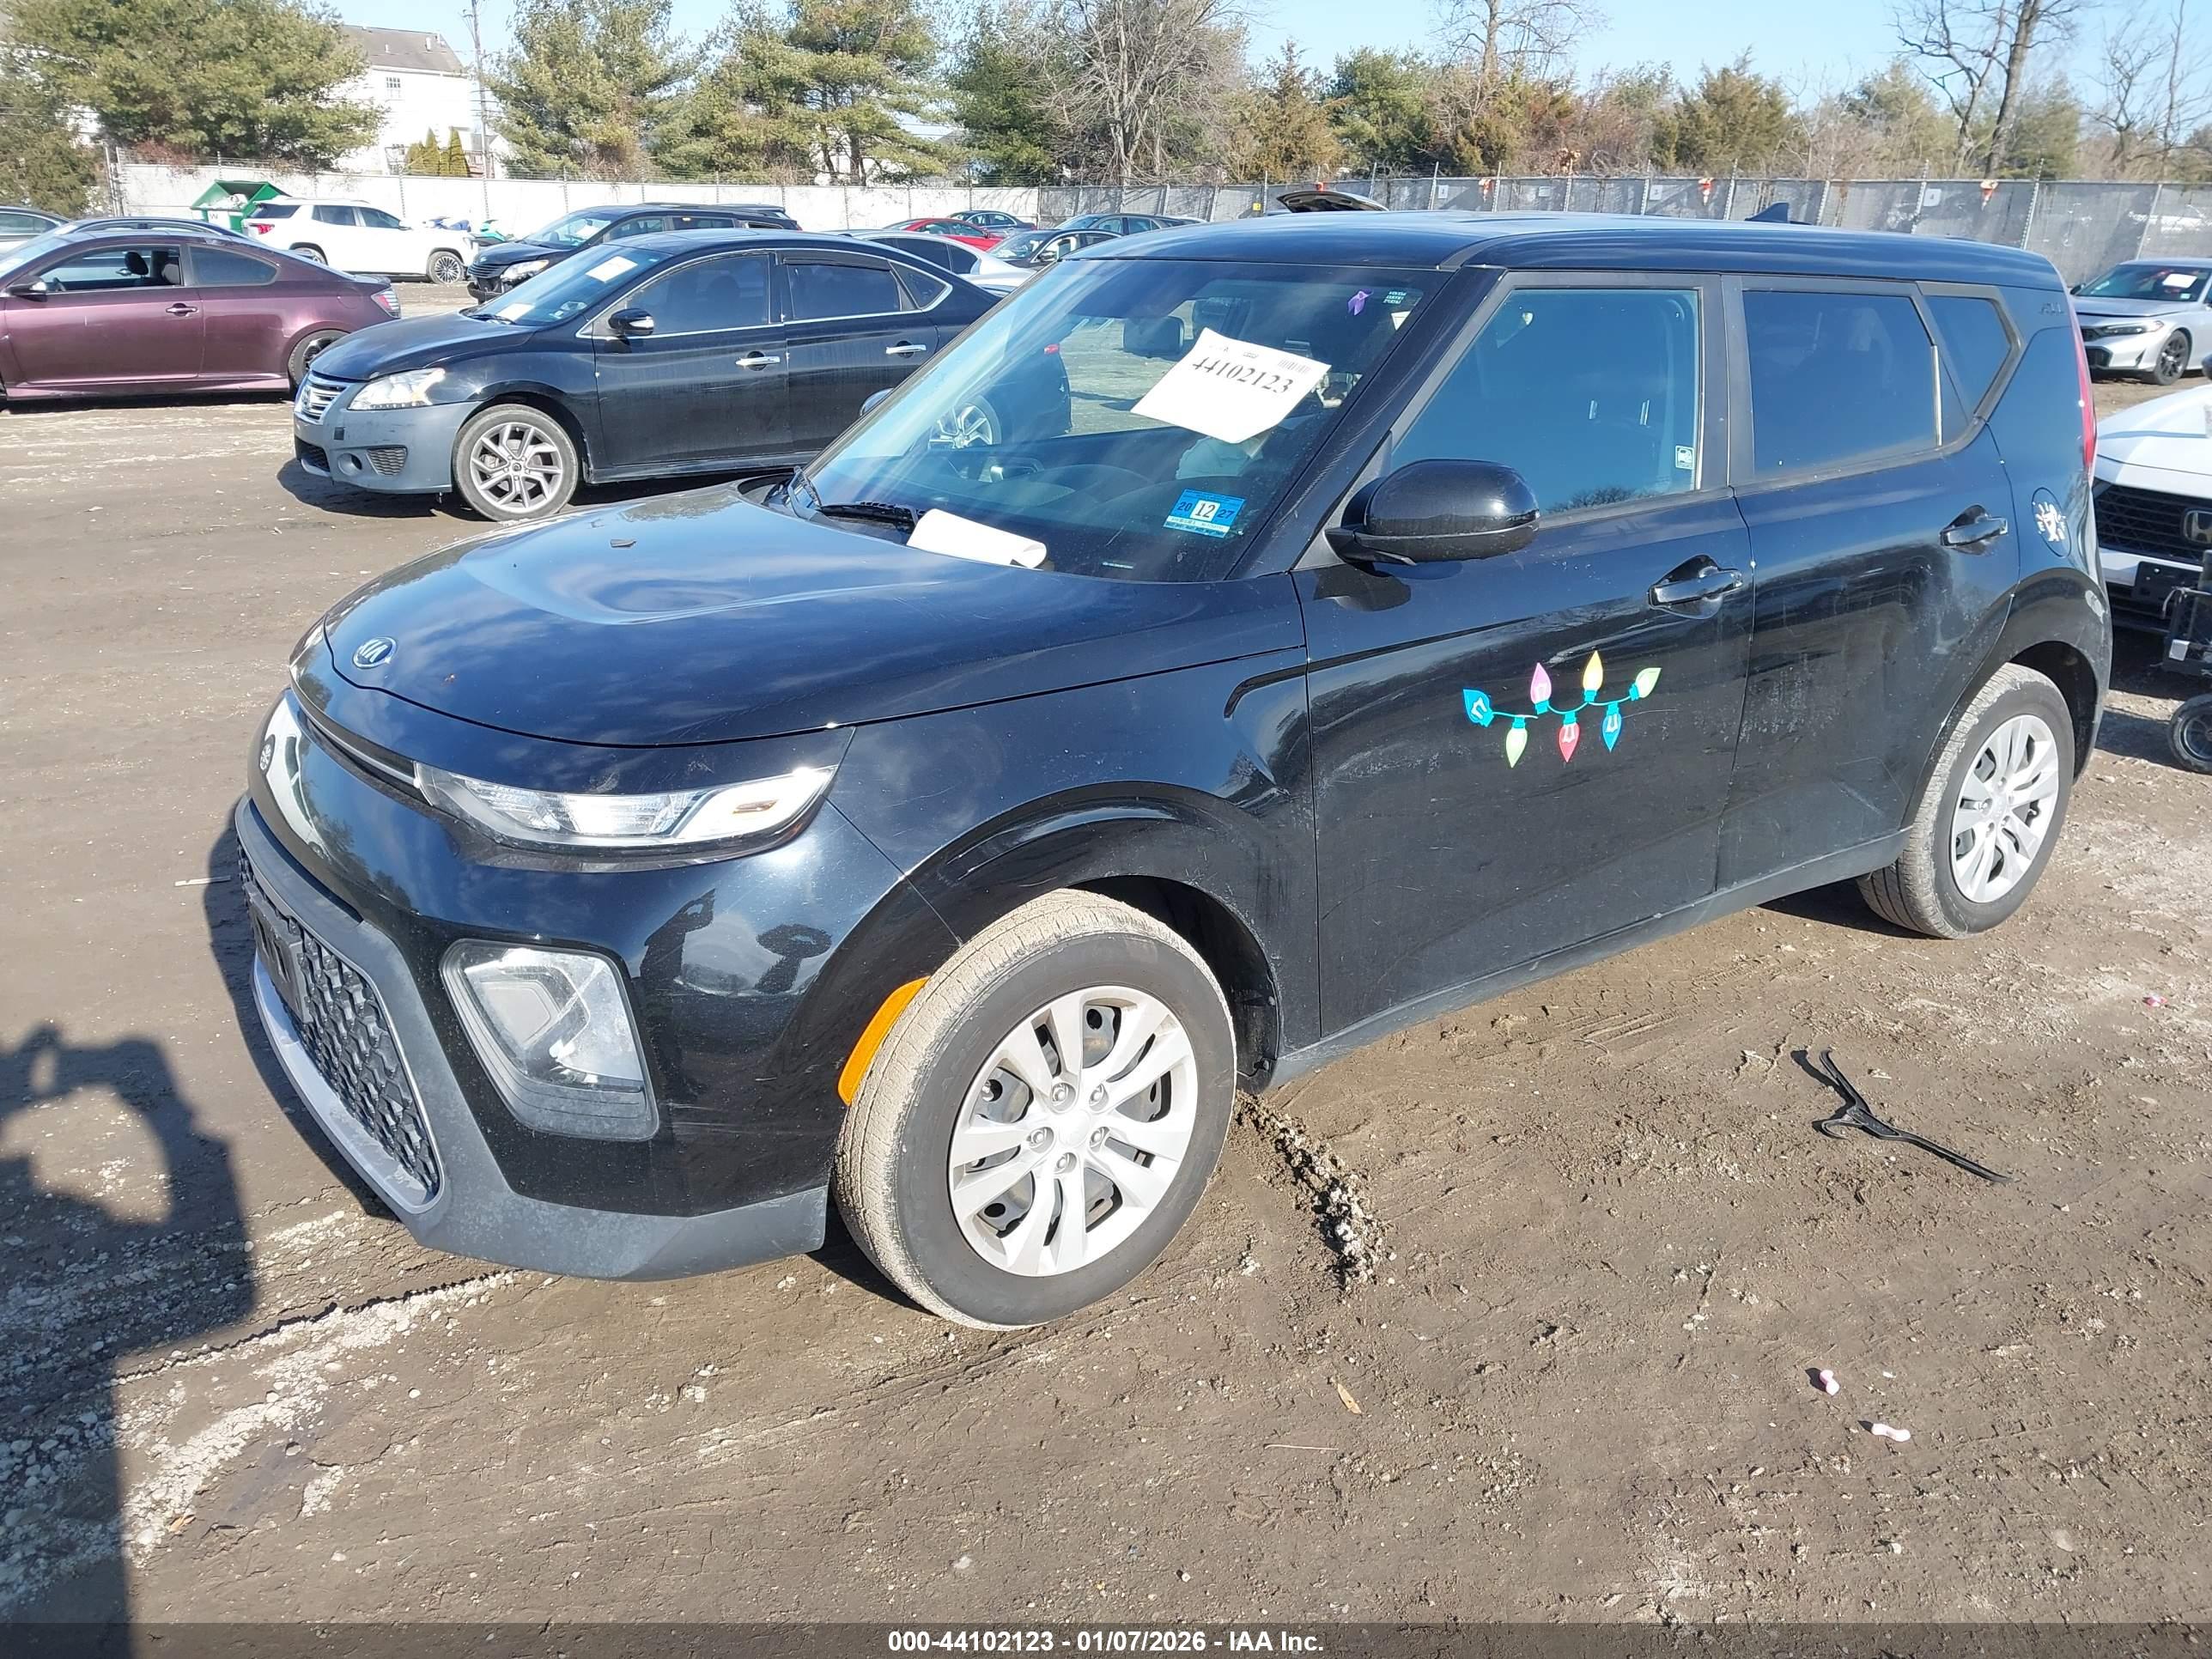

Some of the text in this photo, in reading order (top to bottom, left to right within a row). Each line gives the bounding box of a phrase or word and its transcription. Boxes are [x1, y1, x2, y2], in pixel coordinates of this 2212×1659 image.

[1192, 356, 1294, 393] 44102123
[1177, 501, 1235, 520] 20 12 27
